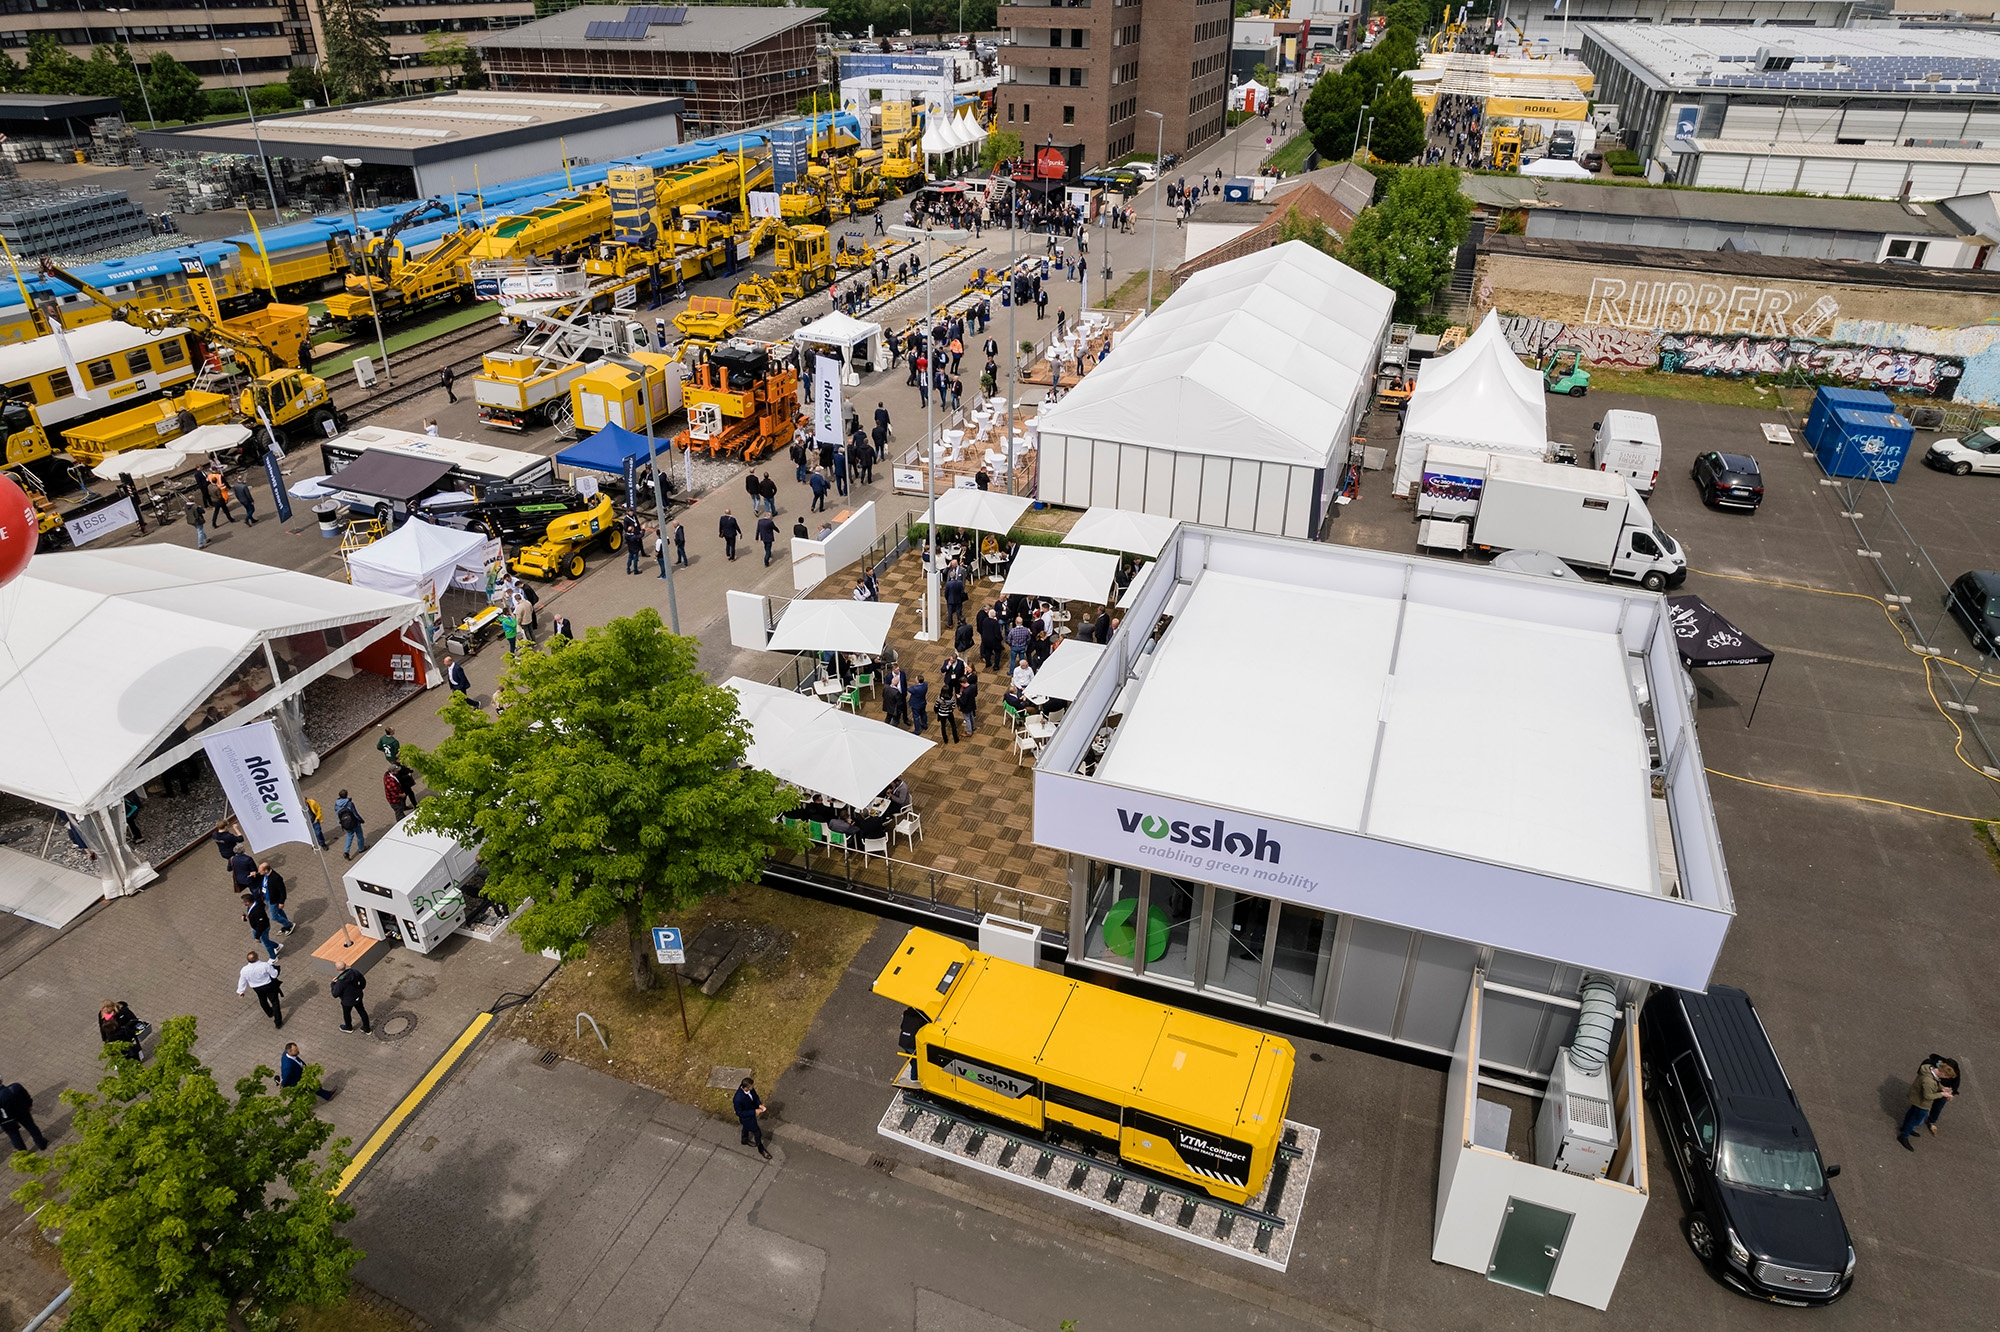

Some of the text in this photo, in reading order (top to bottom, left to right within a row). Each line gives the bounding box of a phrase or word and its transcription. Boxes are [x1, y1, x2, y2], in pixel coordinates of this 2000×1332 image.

[1249, 92, 1254, 100] F
[1524, 105, 1559, 113] ROBEL
[1584, 277, 1794, 337] RUBBER
[113, 386, 136, 395] ZEPPELIN
[84, 514, 107, 529] BSB
[1116, 808, 1282, 864] vossloh
[1138, 844, 1318, 892] enabling green mobility
[658, 931, 675, 949] P
[958, 1066, 1018, 1093] vossloh
[1180, 1133, 1246, 1162] VTM-compact
